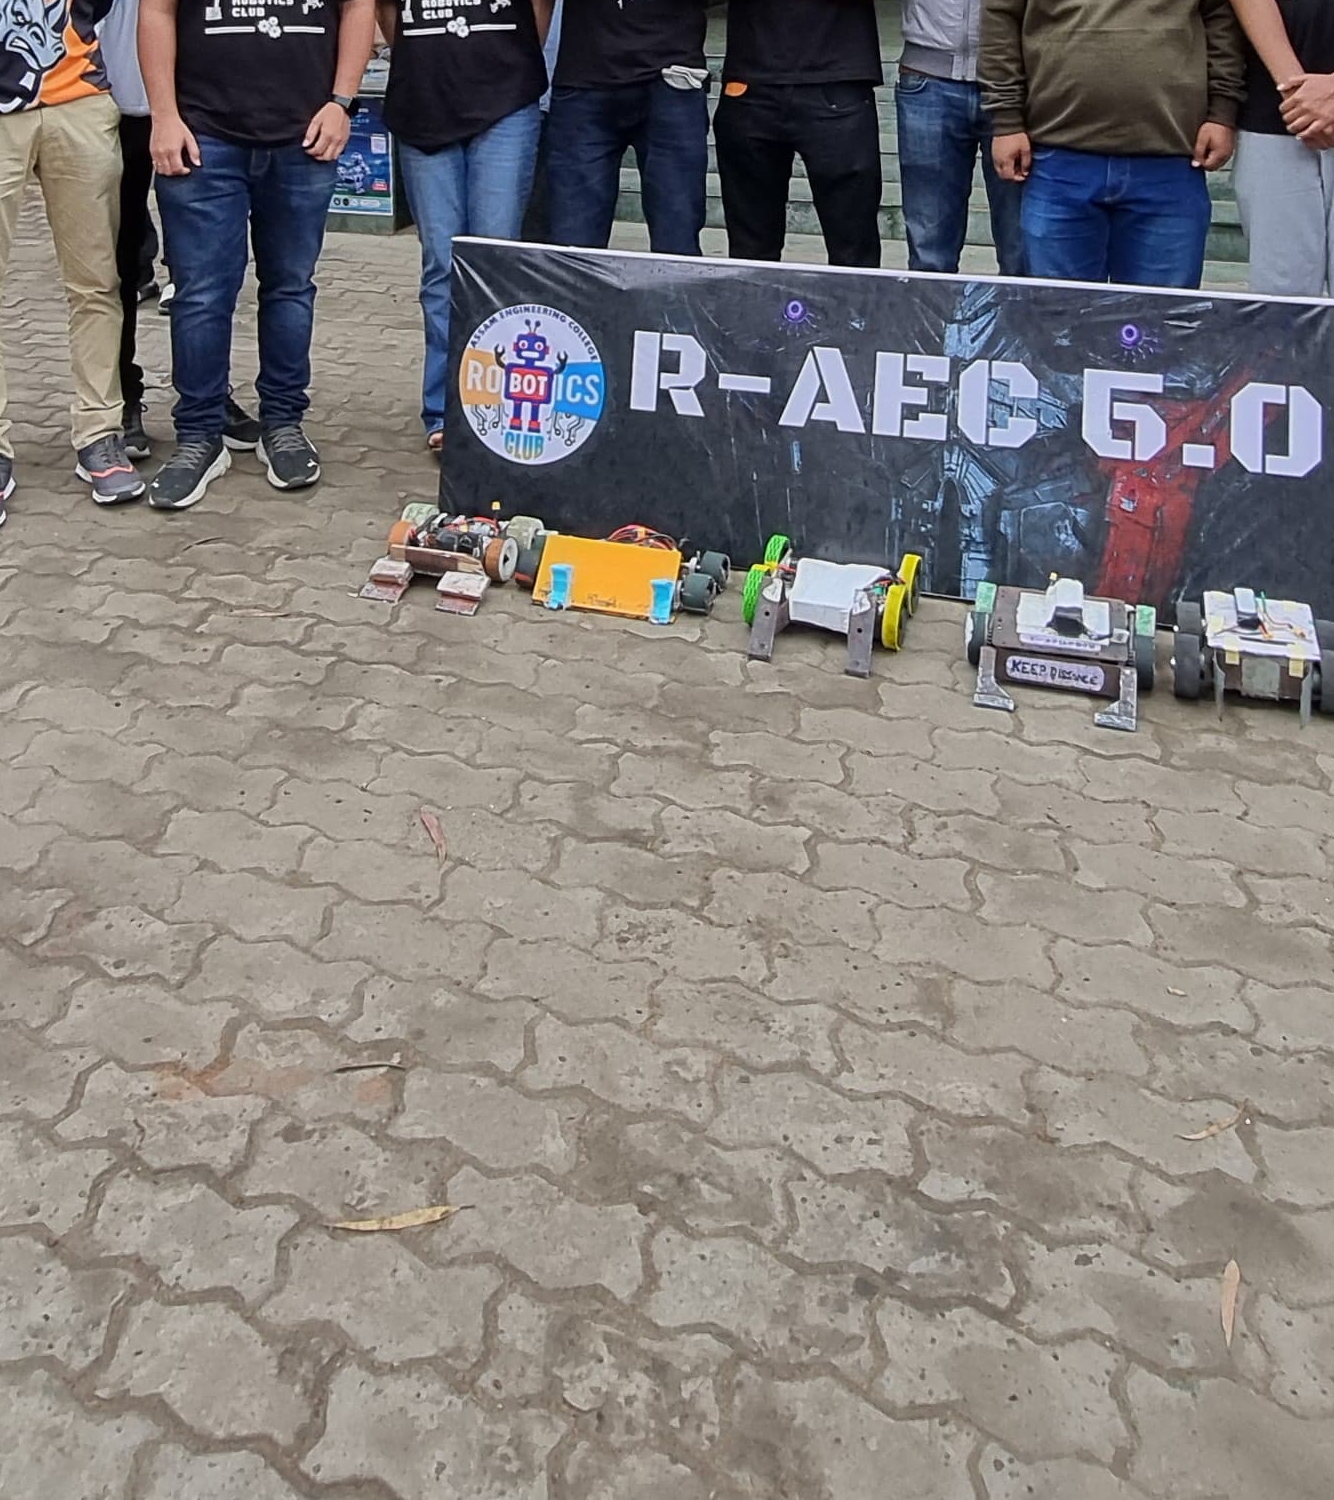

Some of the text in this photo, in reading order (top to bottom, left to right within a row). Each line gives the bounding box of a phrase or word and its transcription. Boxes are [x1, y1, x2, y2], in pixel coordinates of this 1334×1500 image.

[232, 7, 265, 17] CLUB
[422, 8, 453, 20] CLUB
[470, 305, 599, 362] ASSAM ENGINEERING COLLEGE
[629, 330, 1039, 449] R-AEC
[504, 431, 545, 461] CLUB
[1011, 659, 1047, 677] KEEP
